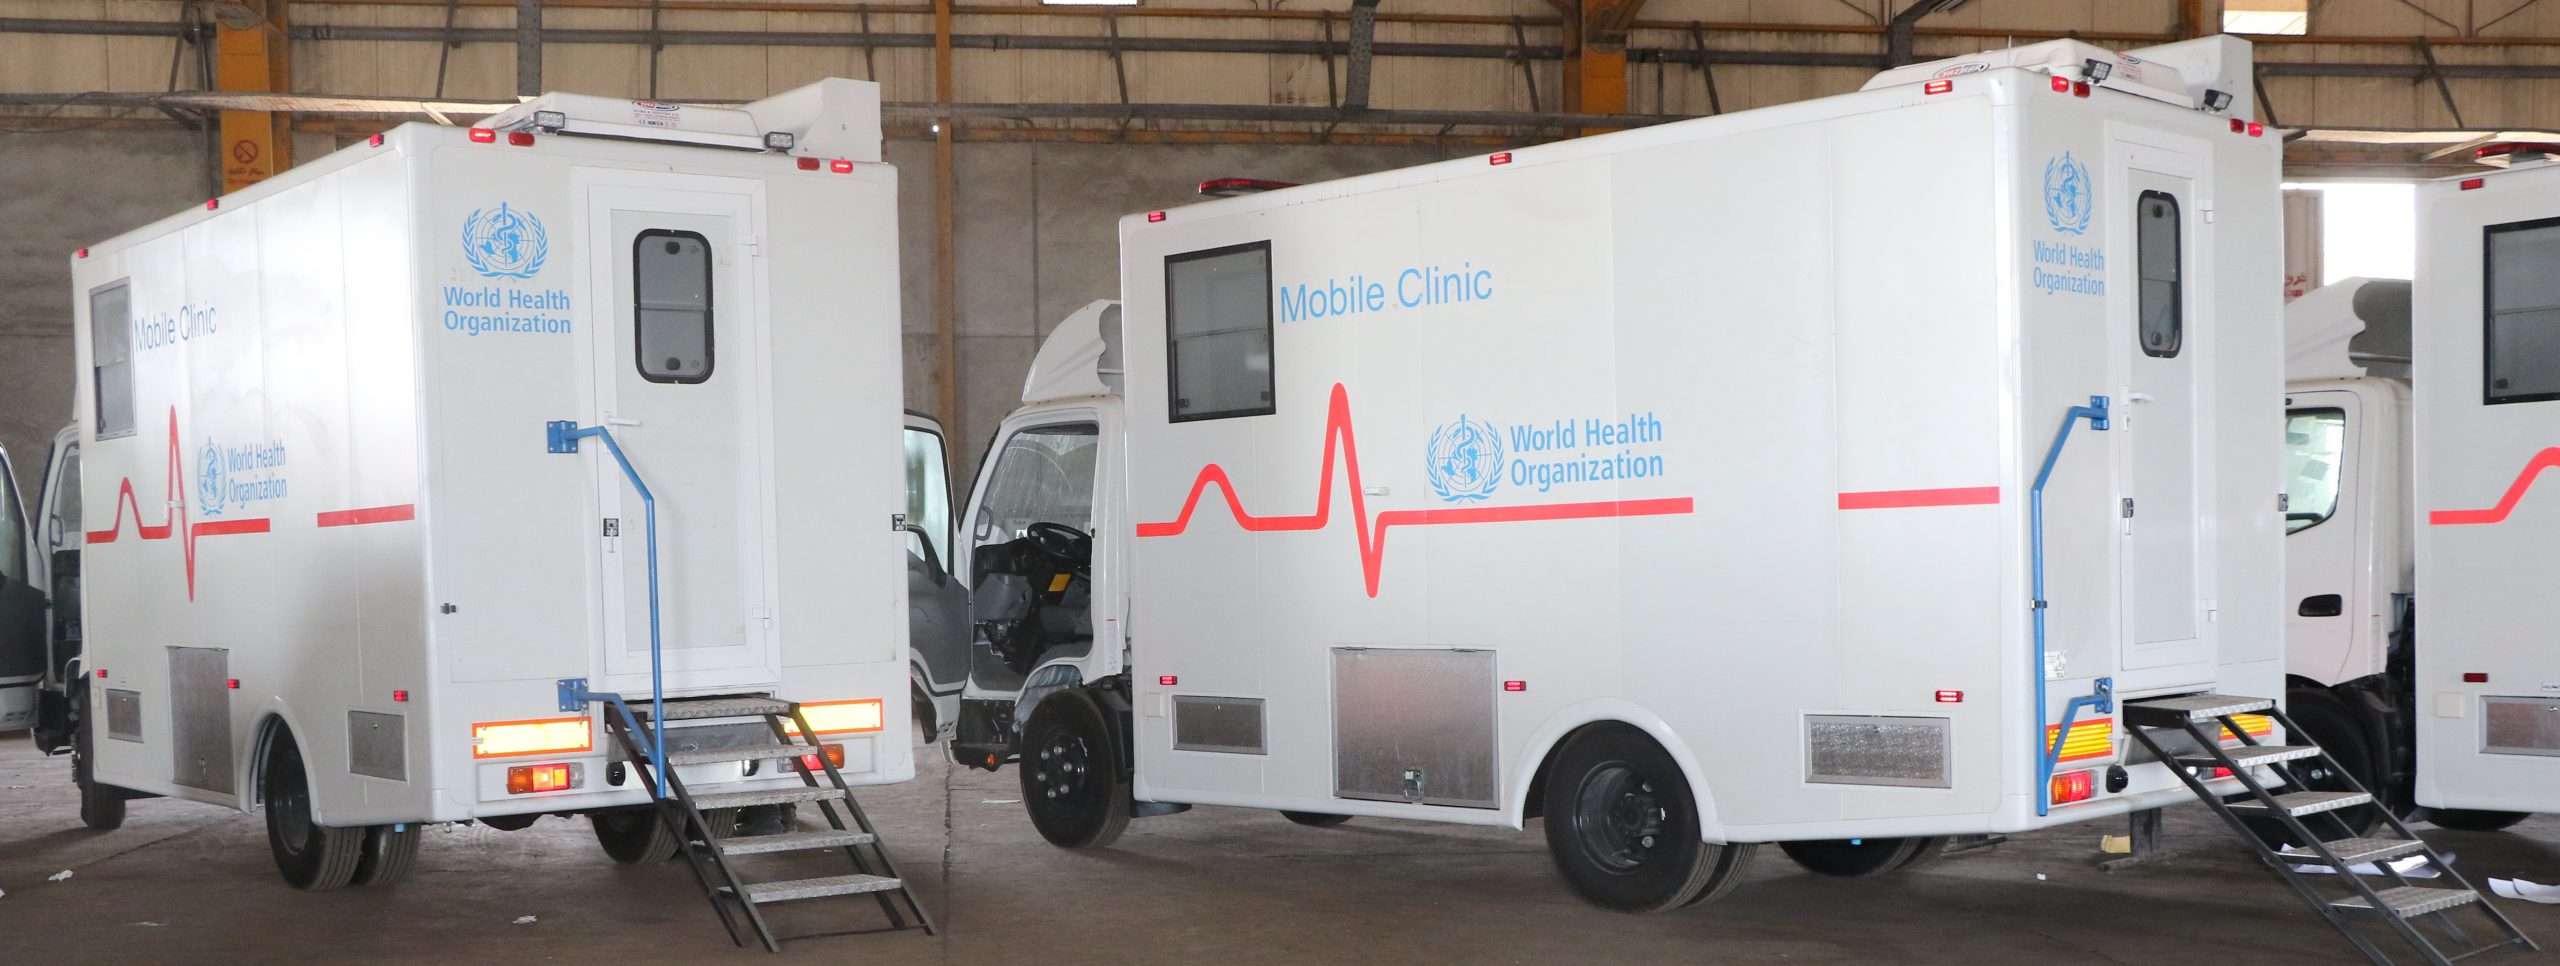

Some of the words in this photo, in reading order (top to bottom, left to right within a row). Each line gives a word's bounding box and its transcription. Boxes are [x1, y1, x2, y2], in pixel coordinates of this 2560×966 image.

[2033, 240, 2066, 265] World
[2070, 246, 2104, 271] Health
[443, 286, 501, 308] World
[509, 289, 570, 310] Health
[1280, 274, 1386, 324] Mobile
[1396, 262, 1494, 307] Clinic
[2033, 266, 2104, 296] Organization
[134, 312, 176, 353] Mobile
[179, 301, 217, 341] Clinic
[444, 310, 572, 336] Organization
[1510, 417, 1577, 453] World
[1585, 411, 1663, 446] Health
[228, 443, 253, 473] World
[256, 439, 286, 467] Health
[1510, 449, 1664, 493] Organization
[229, 473, 287, 509] Organization
